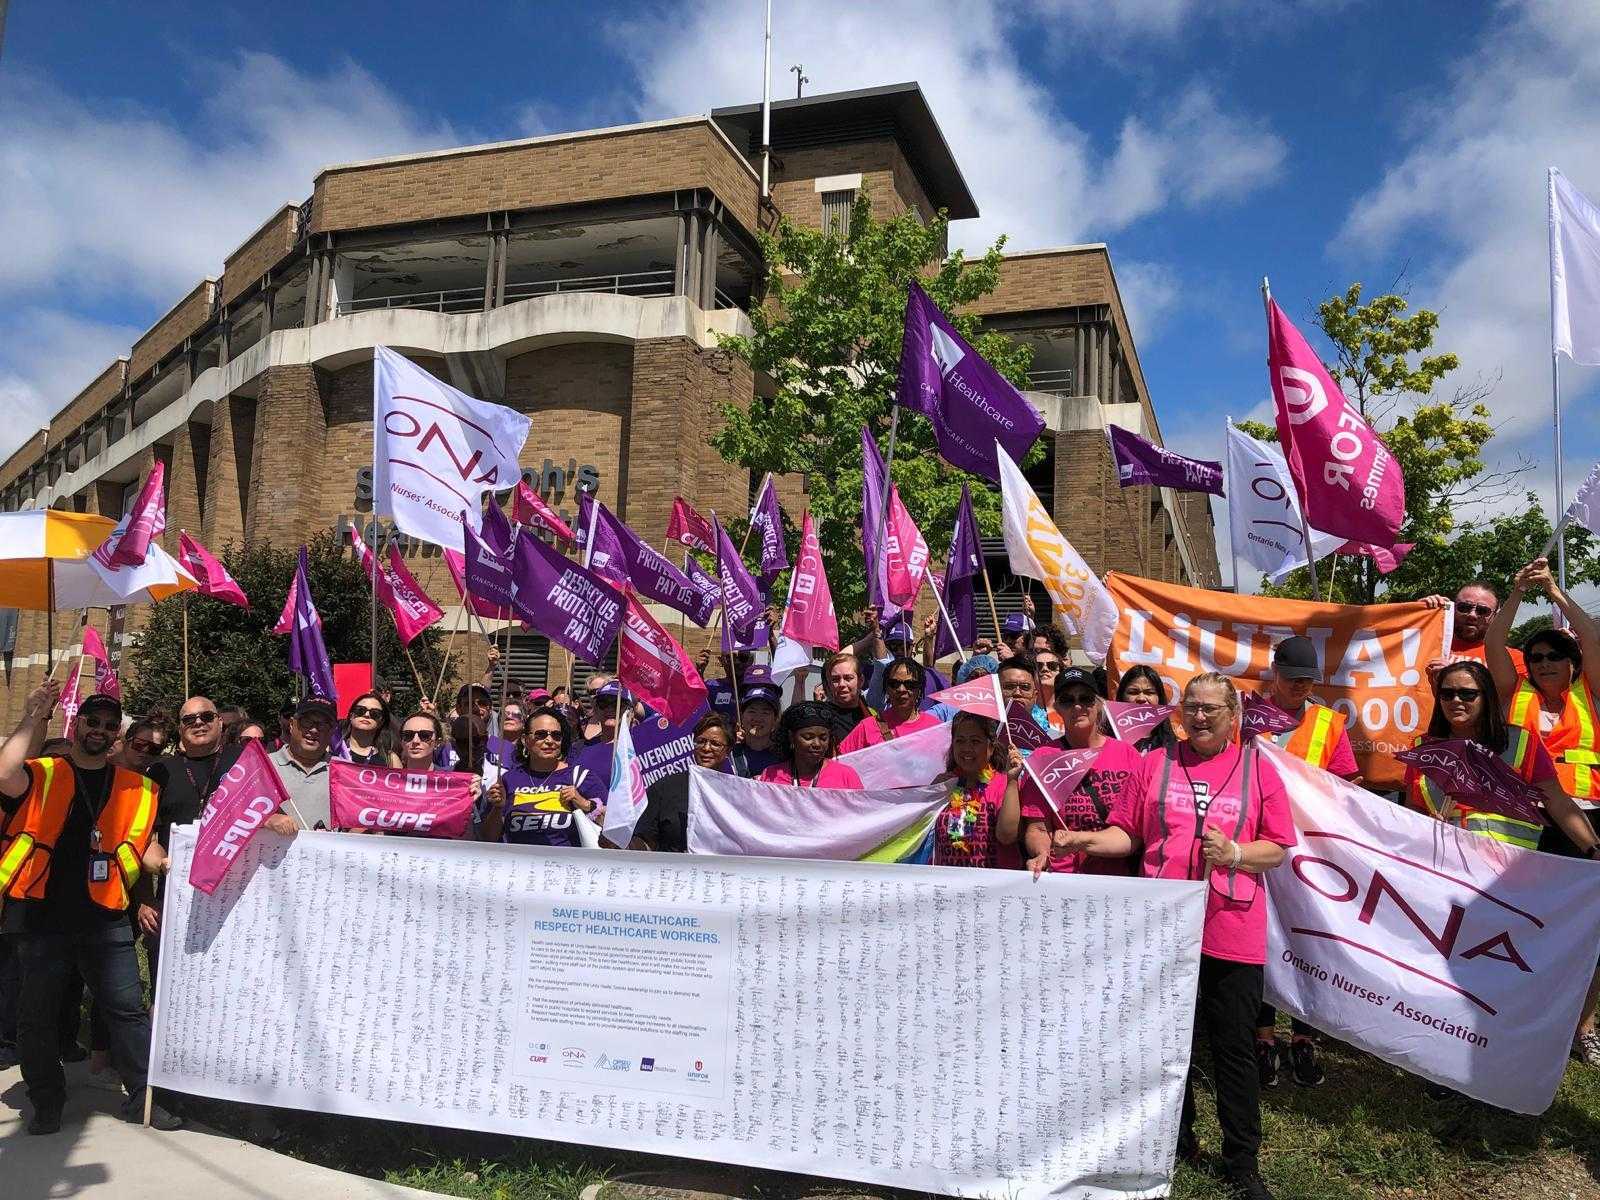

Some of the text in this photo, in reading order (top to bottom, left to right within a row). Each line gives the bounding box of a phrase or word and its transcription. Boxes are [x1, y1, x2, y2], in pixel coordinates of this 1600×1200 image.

[948, 371, 1015, 431] Healthcare
[384, 410, 499, 487] ONA
[558, 568, 620, 622] RESPECT US.
[655, 575, 693, 606] PAY US.
[547, 584, 597, 625] PROTECT
[593, 616, 607, 641] US.
[563, 619, 603, 660] PAY US.
[953, 692, 995, 701] ONA
[1117, 711, 1155, 727] ONA
[1008, 723, 1042, 744] ONA
[1043, 757, 1084, 785] ONA
[1420, 755, 1457, 769] ONA
[359, 769, 450, 793] OCHU
[514, 785, 550, 794] LOCAL
[358, 808, 437, 831] CUPE
[510, 813, 572, 832] SEIU
[552, 908, 700, 929] SAVE PUBLIC HEALTHCARE.
[1291, 855, 1535, 973] ONA
[534, 921, 721, 945] RESPECT HEALTHCARE WORKERS.
[1281, 949, 1329, 982] Ontario
[1392, 1001, 1490, 1049] Association
[562, 1051, 586, 1059] ONA
